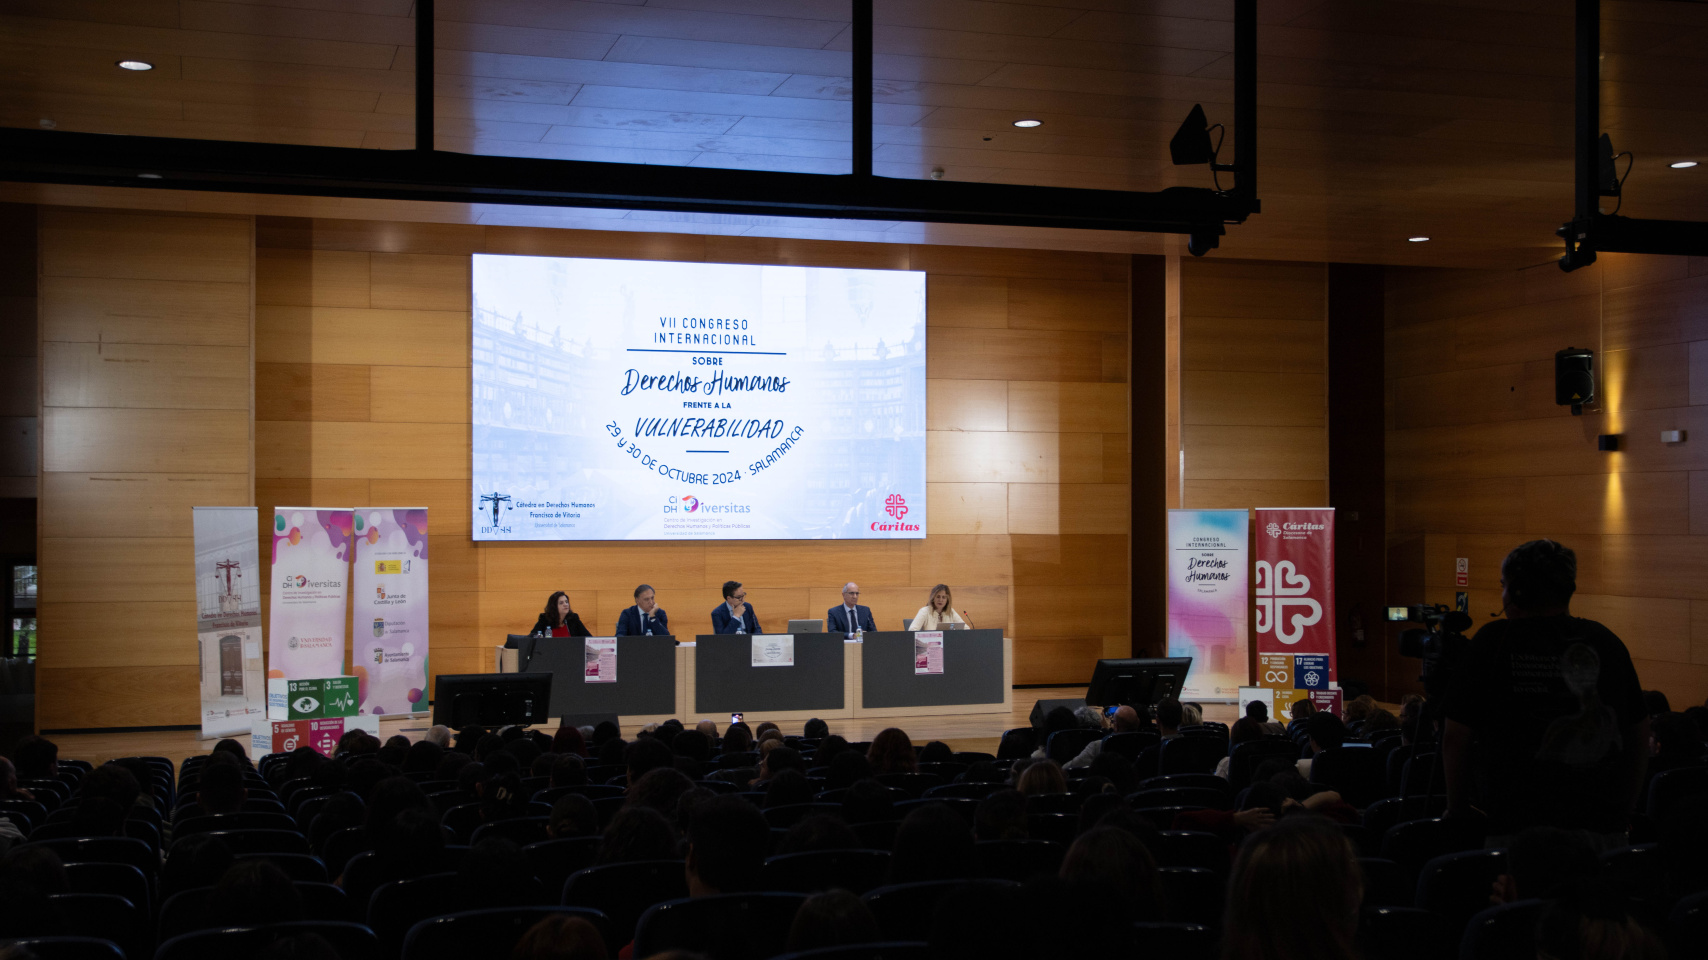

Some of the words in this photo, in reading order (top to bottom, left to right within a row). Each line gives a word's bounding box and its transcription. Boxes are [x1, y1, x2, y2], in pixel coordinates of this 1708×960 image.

[660, 317, 676, 328] VII
[683, 318, 748, 330] CONGRESO
[654, 333, 756, 346] INTERNACIONAL
[692, 357, 723, 365] SOBRE
[621, 369, 702, 395] Derechos
[703, 370, 790, 395] Humanos
[635, 417, 784, 438] VULNERABILIDAD
[606, 421, 622, 437] 29
[617, 438, 627, 447] y
[627, 443, 642, 458] 30
[642, 455, 657, 470] DE
[658, 464, 708, 485] OCTUBRE
[712, 470, 742, 485] 2024
[749, 426, 804, 476] SALAMANCA
[871, 521, 920, 531] Cáritas
[1283, 522, 1325, 530] Cáritas
[1187, 557, 1228, 570] Derechos
[1185, 570, 1230, 582] Humanos
[289, 683, 297, 691] 13
[326, 681, 331, 690] 3
[274, 724, 279, 733] 5
[311, 722, 318, 731] 10
